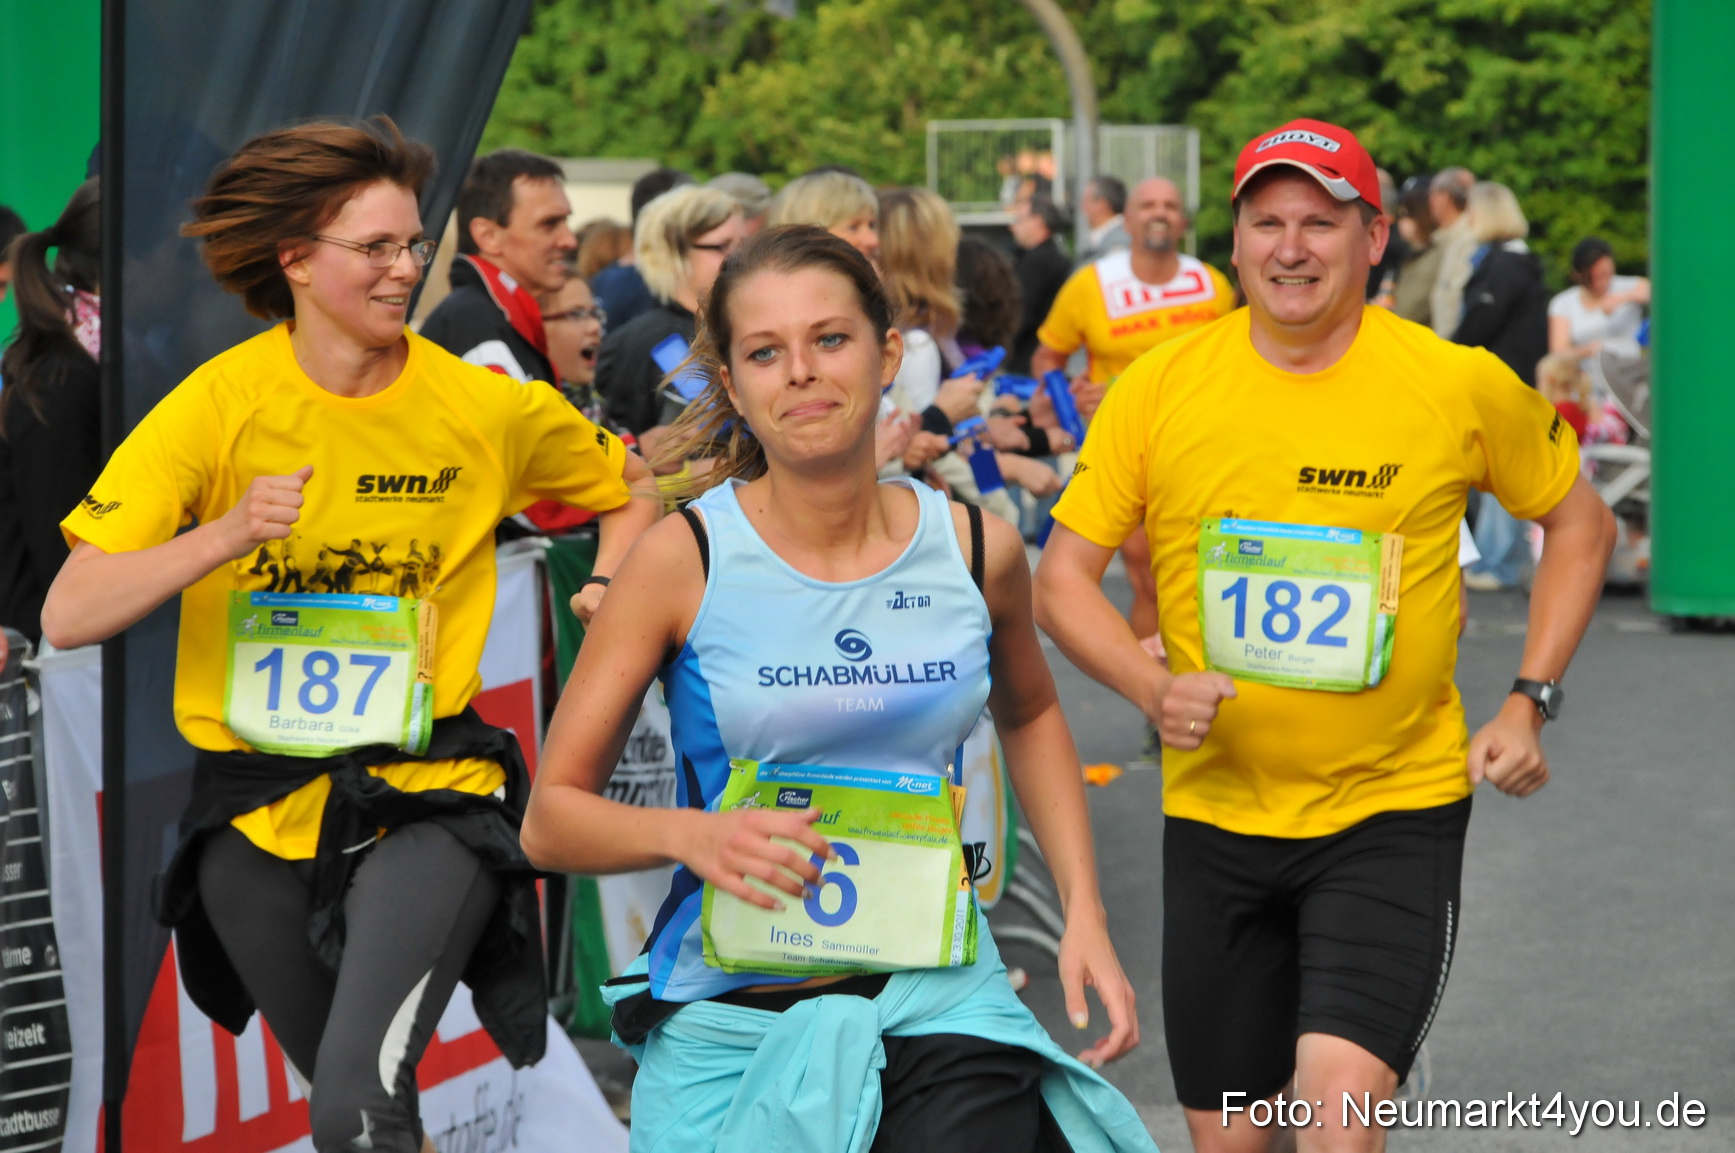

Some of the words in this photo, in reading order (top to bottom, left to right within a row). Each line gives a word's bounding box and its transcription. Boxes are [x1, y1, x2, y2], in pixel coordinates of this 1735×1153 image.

[356, 474, 428, 494] swn
[1298, 466, 1367, 488] swn
[355, 495, 403, 503] stadtwerke
[405, 495, 445, 503] neumarkt
[1296, 486, 1341, 496] stadtwerke
[1343, 489, 1385, 499] neumarkt
[1224, 552, 1288, 568] firmenlauf
[1221, 576, 1352, 648] 182
[257, 624, 325, 638] firmenlauf
[1244, 644, 1283, 660] Peter
[254, 647, 392, 717] 187
[757, 660, 958, 687] SCHABMÜLLER
[834, 696, 885, 713] TEAM
[269, 715, 334, 732] Barbara
[802, 841, 861, 927] 6
[770, 926, 814, 947] Ines
[821, 940, 880, 956] Sammüller
[782, 953, 806, 962] Team
